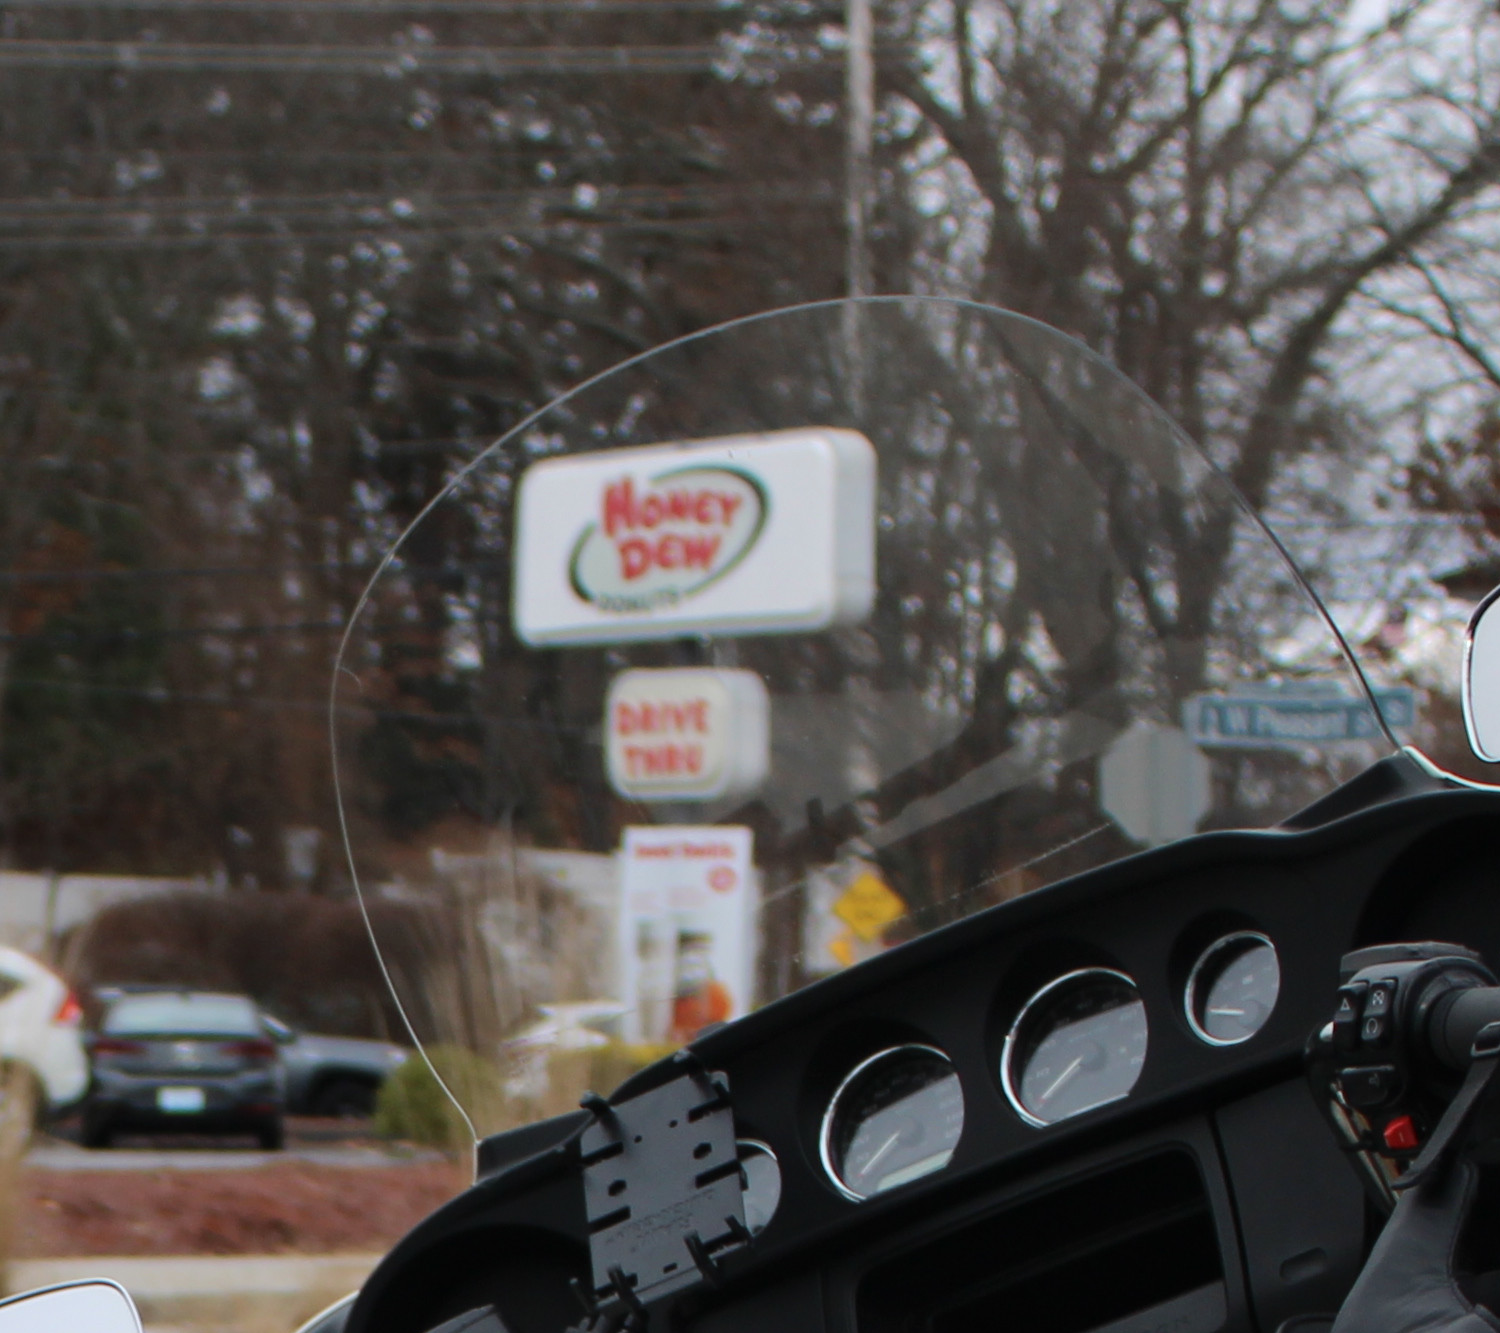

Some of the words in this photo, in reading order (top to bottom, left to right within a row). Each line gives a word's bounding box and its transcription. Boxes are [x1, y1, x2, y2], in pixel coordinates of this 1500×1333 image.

[603, 475, 742, 538] HONEY
[618, 532, 721, 582] DEW
[616, 699, 708, 736] DRIVE
[623, 745, 703, 777] THRU
